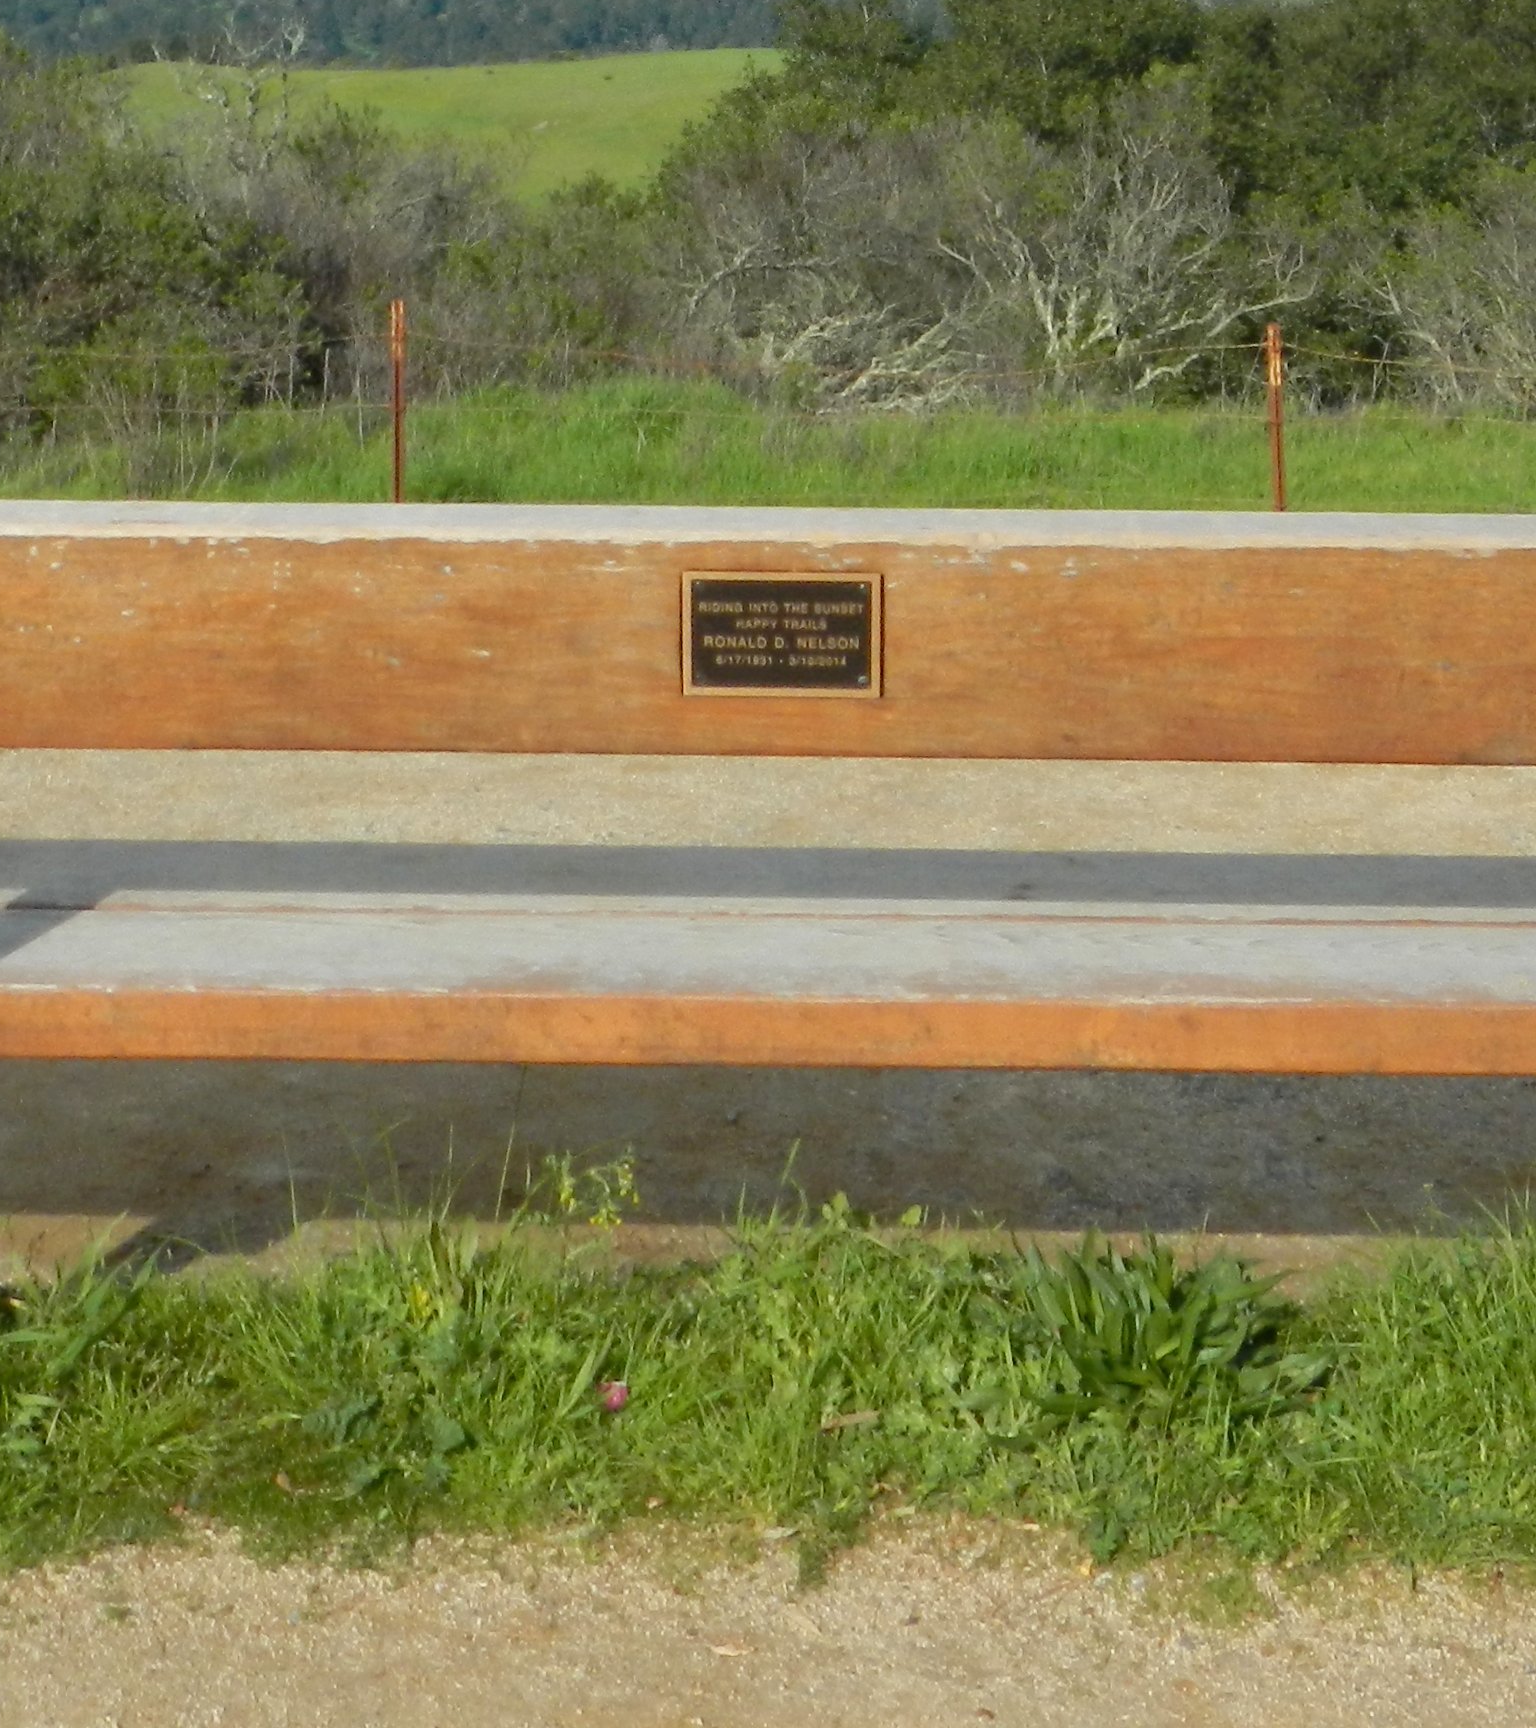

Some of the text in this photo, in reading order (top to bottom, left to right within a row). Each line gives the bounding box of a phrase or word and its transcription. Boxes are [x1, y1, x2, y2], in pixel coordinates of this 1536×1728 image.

[698, 600, 864, 615] RIDING INTO THE SUNSET
[736, 618, 828, 631] HAPPY TRAILS
[703, 634, 767, 649] RONALD
[797, 635, 860, 650] NELSON
